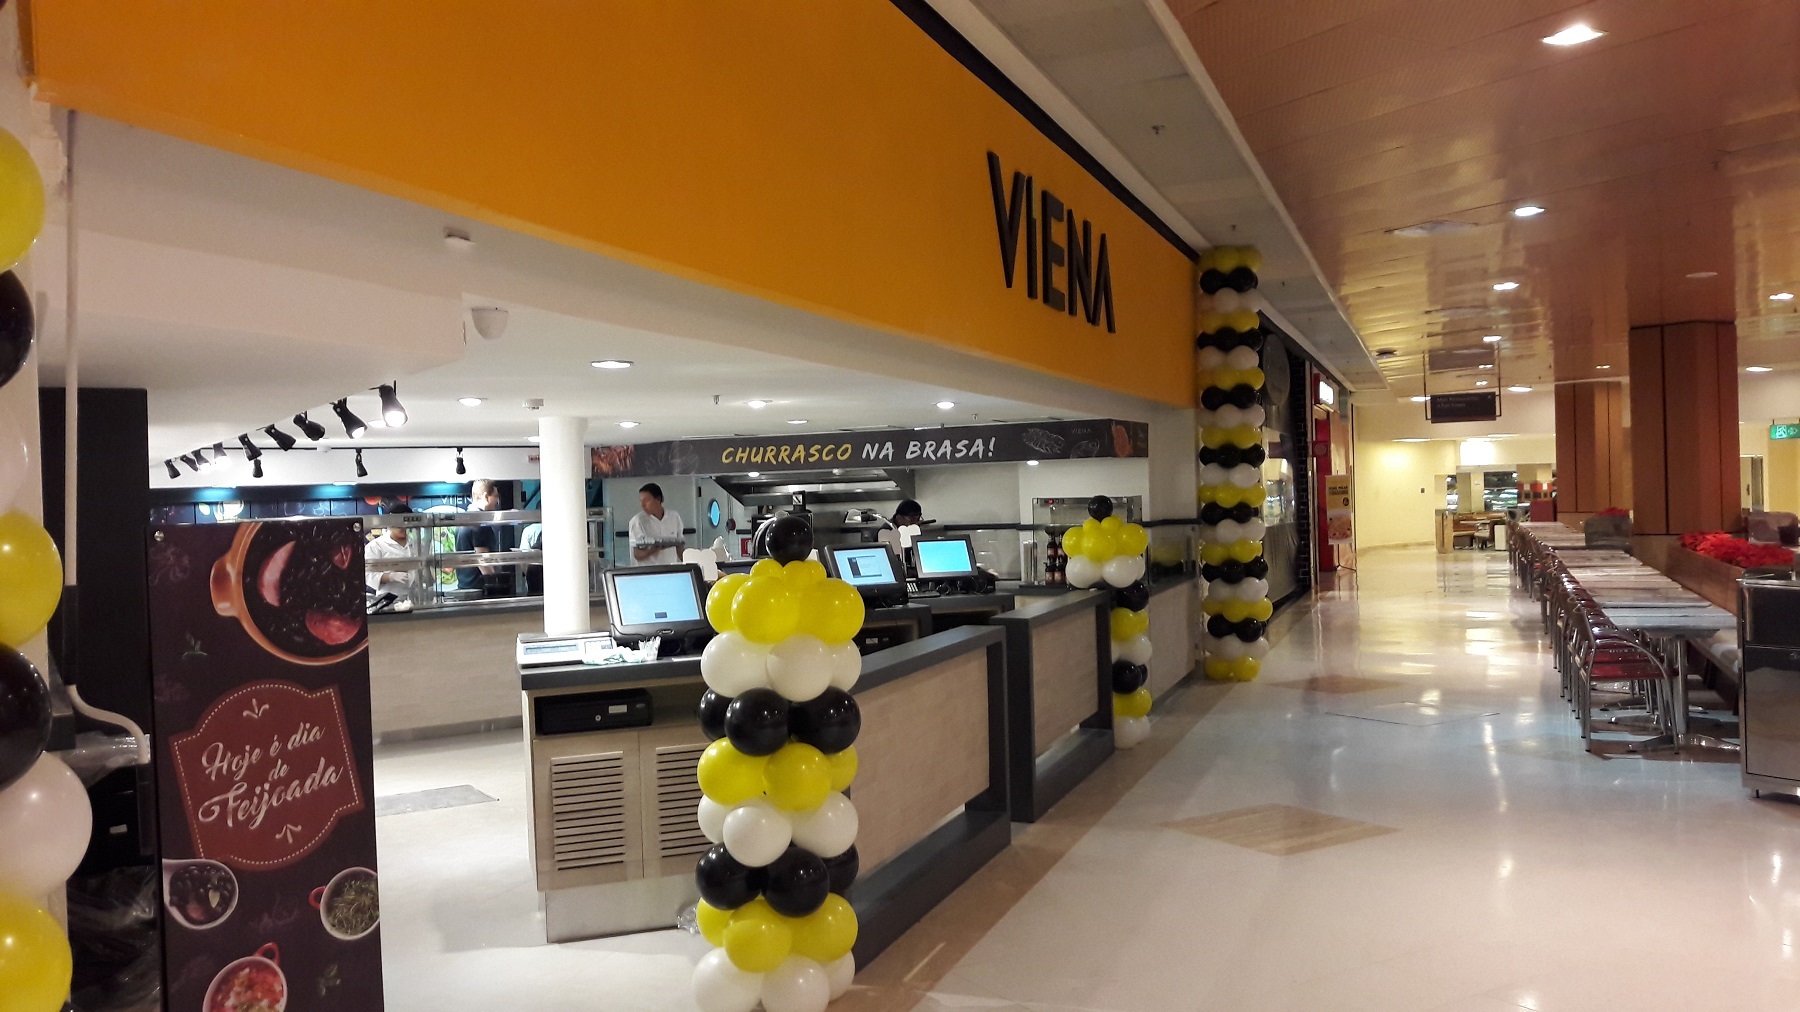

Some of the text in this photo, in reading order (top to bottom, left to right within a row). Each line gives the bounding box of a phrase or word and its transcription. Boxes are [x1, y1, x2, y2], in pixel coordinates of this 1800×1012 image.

[986, 151, 1116, 333] VIENA
[721, 436, 996, 465] CHURRASCO NA BRASA!
[202, 722, 326, 781] Hoje é dia
[268, 758, 290, 781] de
[198, 756, 344, 830] Feijoada
